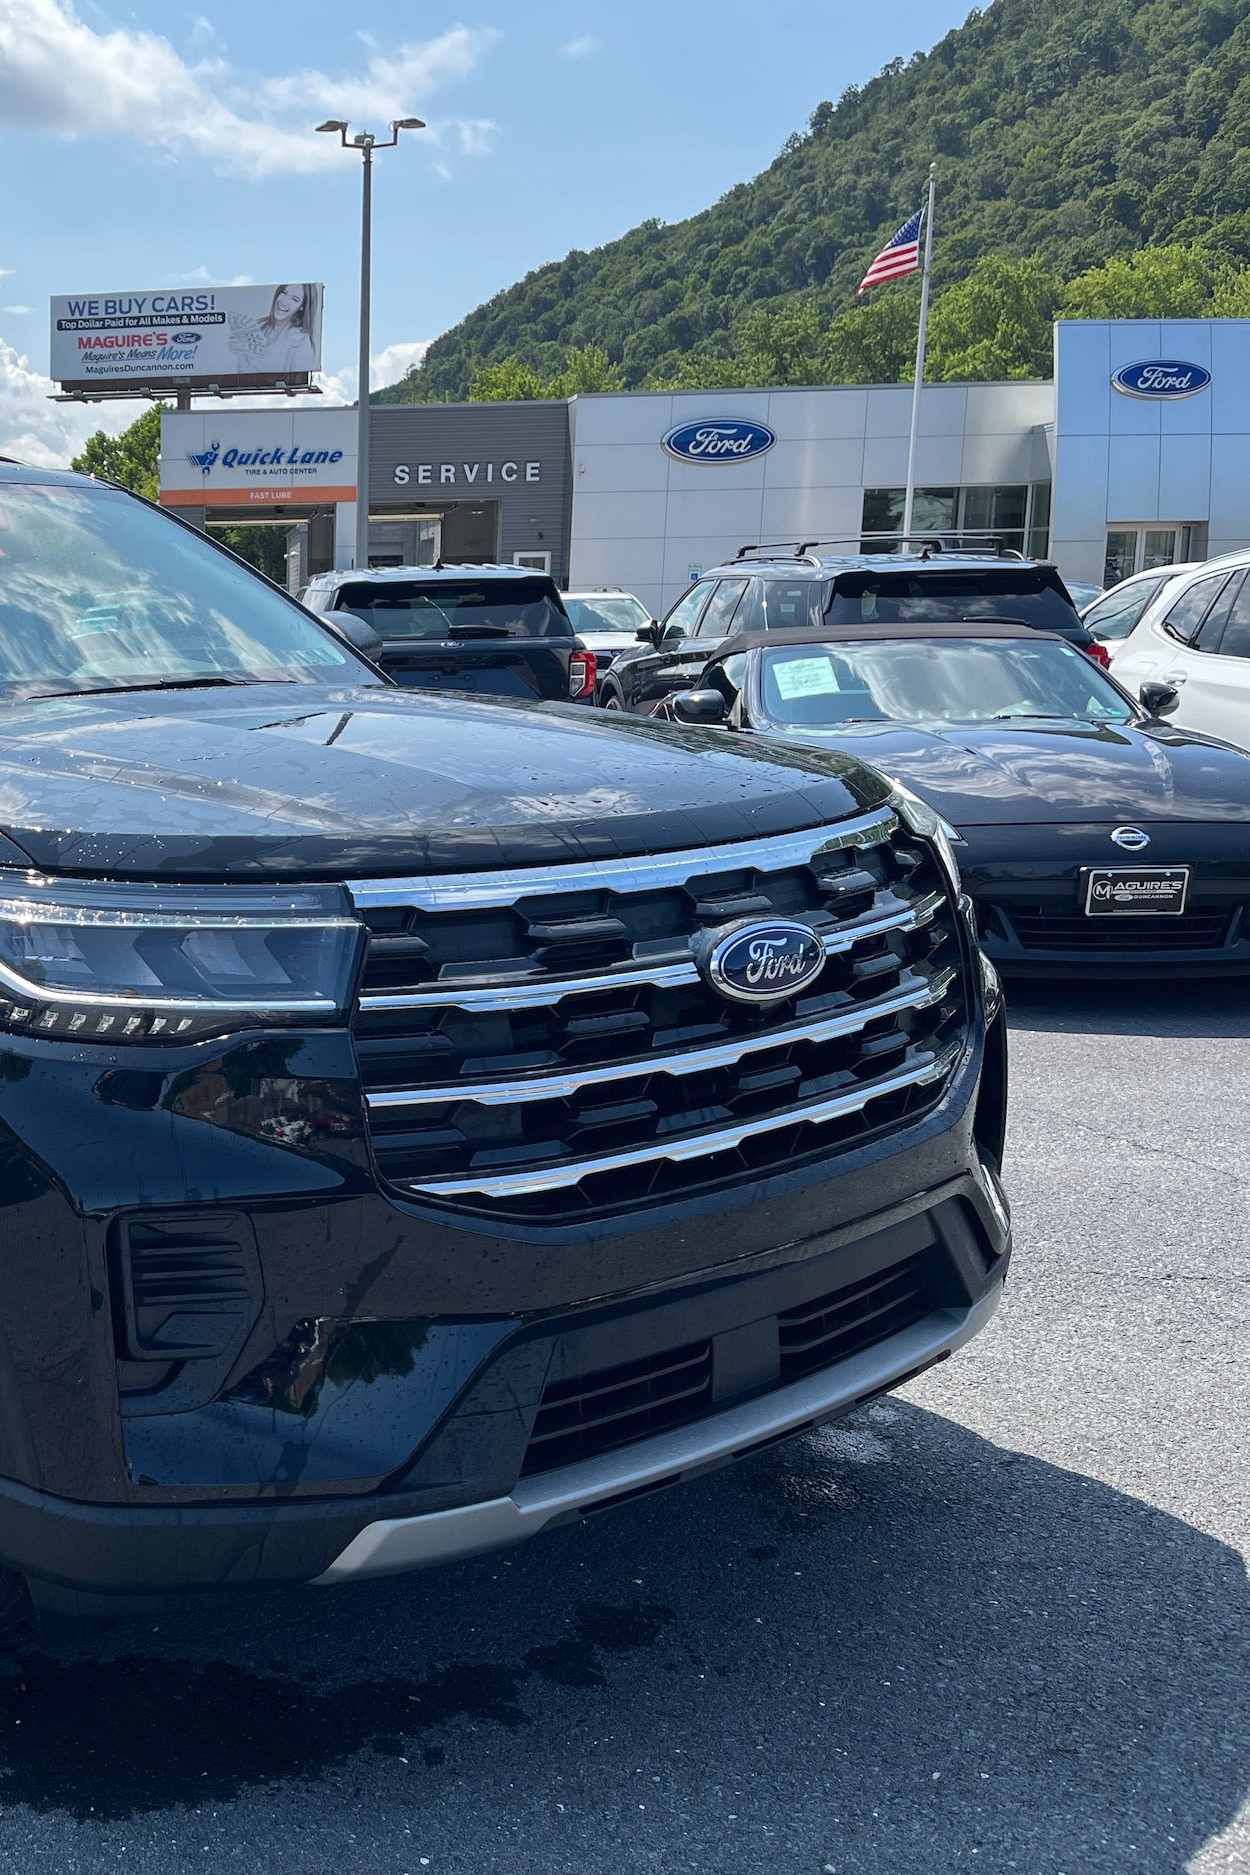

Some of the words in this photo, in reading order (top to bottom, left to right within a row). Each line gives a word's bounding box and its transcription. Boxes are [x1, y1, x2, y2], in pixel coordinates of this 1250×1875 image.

[67, 300, 99, 317] WE
[104, 297, 147, 315] BUY
[151, 294, 215, 313] CARS!
[60, 320, 77, 330] Top
[77, 319, 104, 329] Dollar
[104, 318, 125, 328] Paid
[125, 317, 138, 326] for
[138, 316, 151, 326] All
[152, 315, 181, 325] Makes
[181, 314, 189, 323] &
[190, 313, 223, 323] Models
[77, 331, 168, 350] MAGUIRE'S
[81, 351, 126, 364] Maguire's
[126, 348, 158, 359] Means
[156, 345, 199, 361] More!
[85, 363, 195, 375] MaguiresDuncannon.com
[1137, 366, 1193, 389] Ford
[688, 428, 754, 455] Ford
[222, 447, 286, 468] Quick
[286, 447, 344, 464] Lane
[289, 467, 318, 475] CENTER
[393, 460, 541, 485] SERVICE
[250, 491, 270, 499] FAST
[271, 490, 292, 498] LUBE
[746, 937, 806, 984] Ford
